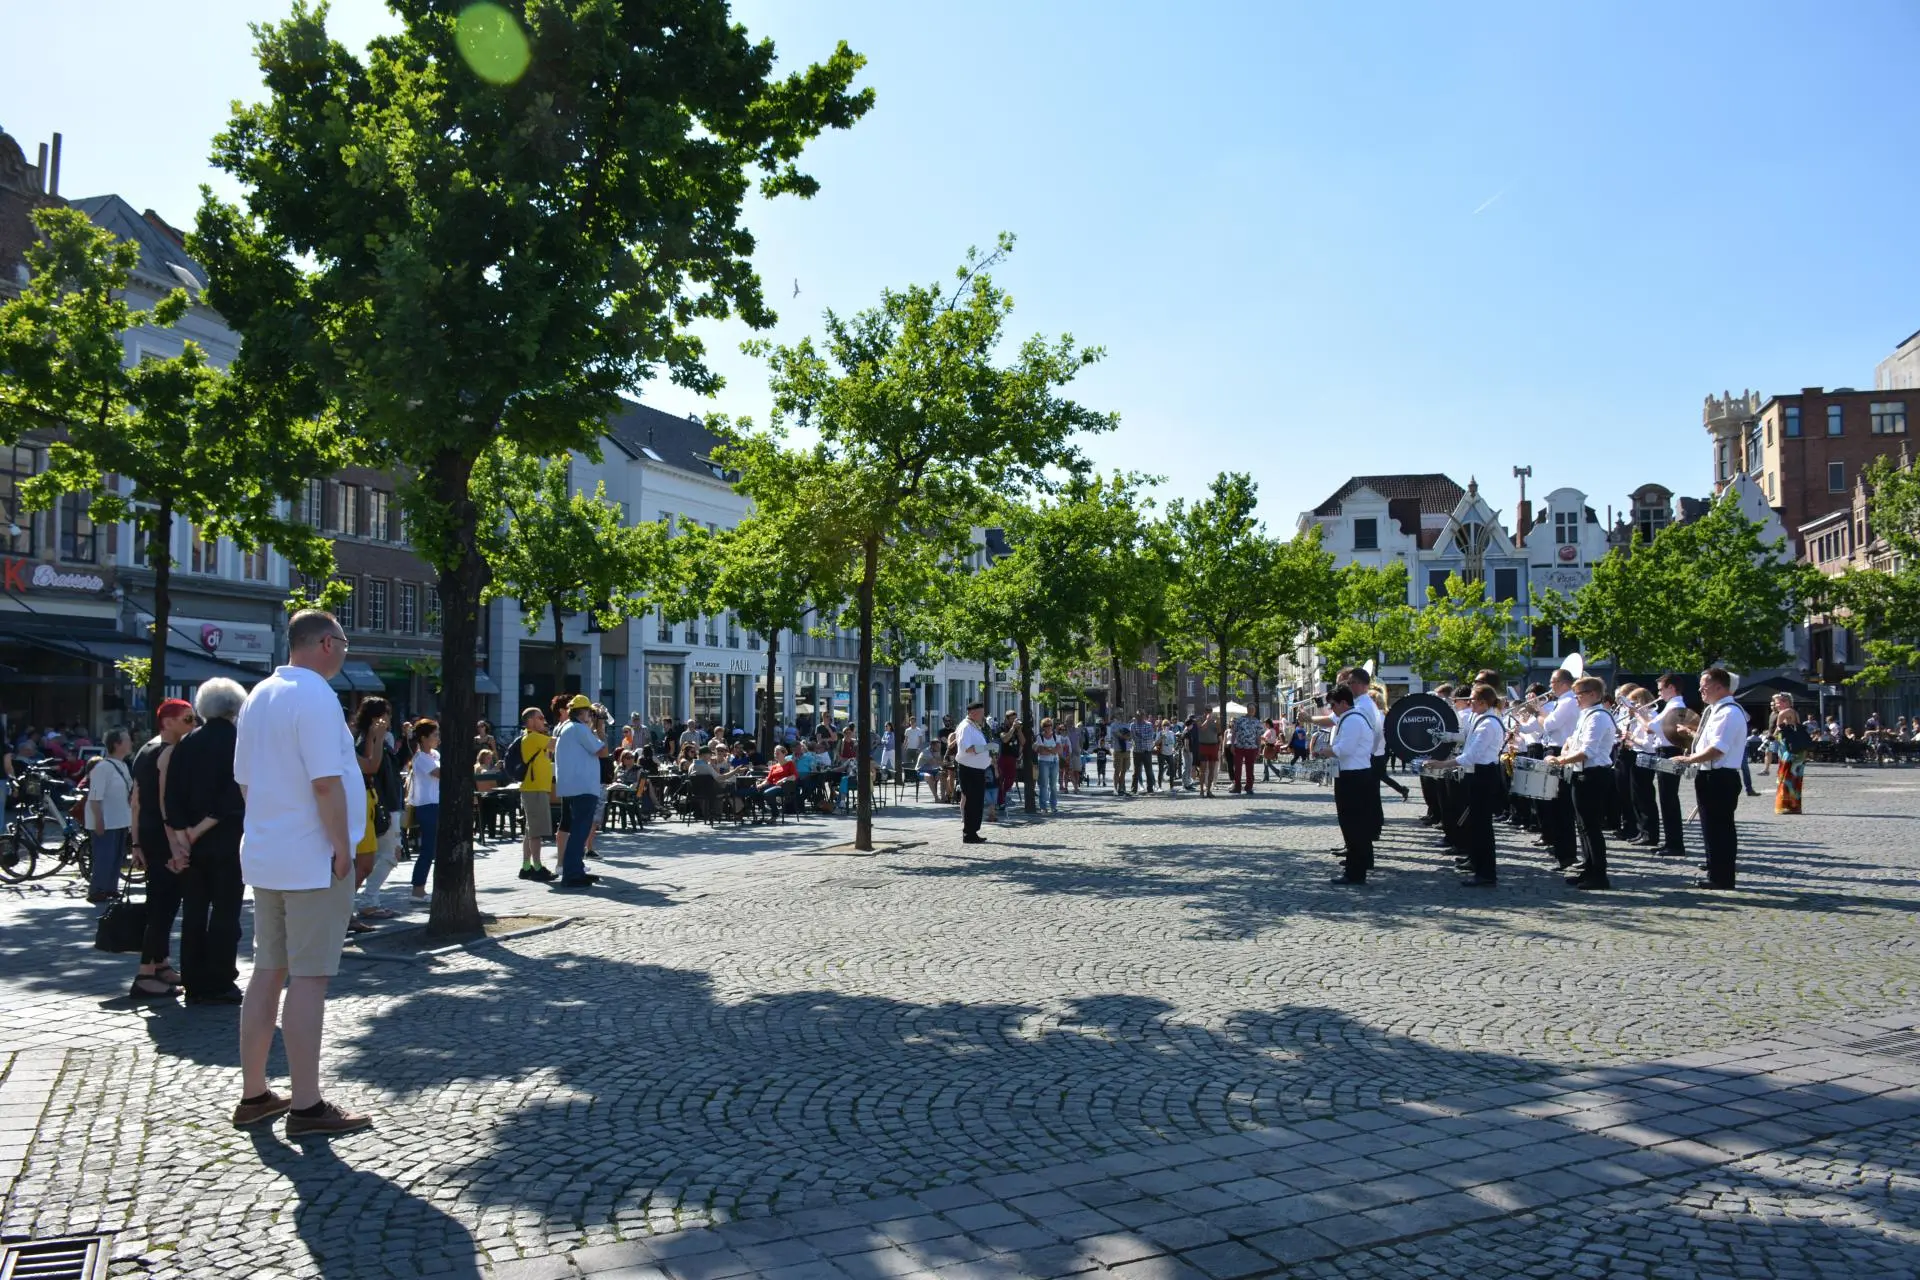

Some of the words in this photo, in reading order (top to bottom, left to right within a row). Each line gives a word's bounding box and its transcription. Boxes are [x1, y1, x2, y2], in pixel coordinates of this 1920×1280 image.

[33, 565, 103, 590] Brasserie
[208, 631, 219, 646] di
[730, 659, 752, 672] PAUL
[1402, 716, 1437, 724] AMICITIA
